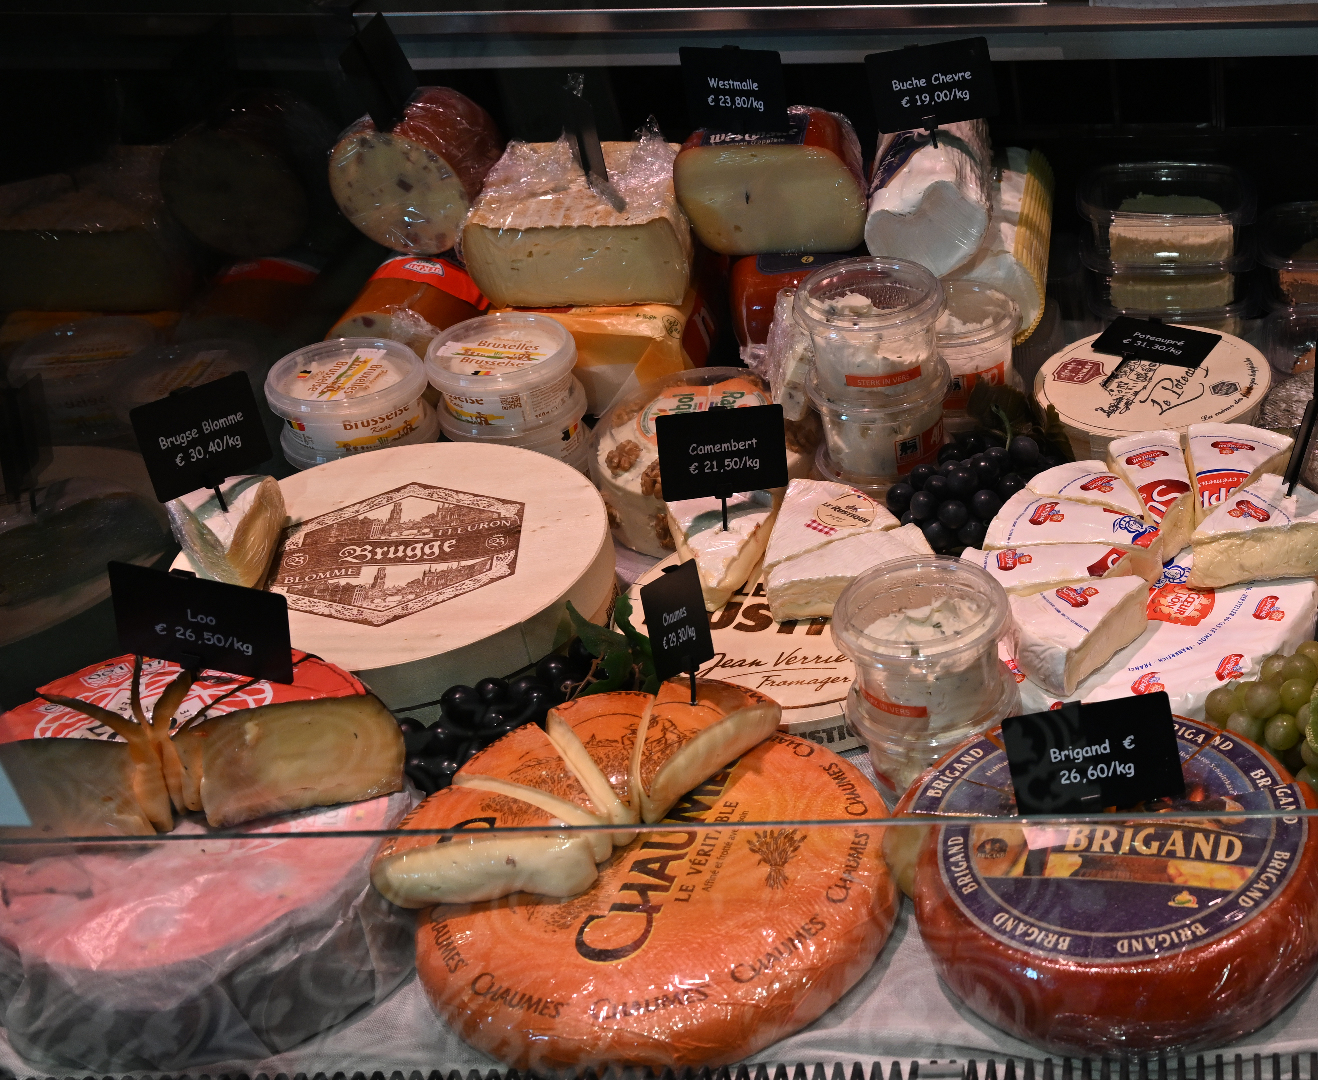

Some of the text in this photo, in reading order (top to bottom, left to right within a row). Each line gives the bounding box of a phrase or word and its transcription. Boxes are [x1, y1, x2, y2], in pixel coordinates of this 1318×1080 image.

[707, 76, 759, 90] Westmalle
[892, 71, 972, 91] Buche Chevre
[707, 94, 764, 112] € 23,80/kg
[901, 88, 970, 108] € 19,00/kg
[477, 340, 540, 352] Bruxelles
[1133, 331, 1185, 347] Poteaupré
[460, 355, 525, 368] Brusselse
[857, 378, 880, 386] STERK
[882, 377, 890, 385] IN
[158, 411, 244, 450] Brugse Blomme
[370, 423, 392, 434] Kaas
[175, 435, 242, 467] € 30,40/kg
[688, 437, 758, 456] Camembert
[689, 456, 760, 475] € 21,50/kg
[831, 504, 871, 524] RUSTIQUE
[438, 519, 512, 537] FLEURON
[338, 539, 458, 563] Brugge
[284, 567, 357, 585] BLOMME
[187, 608, 217, 627] Loo
[662, 606, 688, 627] Chaumes
[154, 623, 254, 656] € 26,50/kg
[662, 625, 697, 650] € 29,30/kg
[695, 652, 769, 678] Jean
[756, 674, 851, 691] Fromager
[1049, 735, 1135, 763] Brigand €
[926, 748, 984, 798] BRIGAND
[1060, 760, 1135, 786] 26,60/kg
[823, 762, 870, 817] CHAUMES
[674, 800, 740, 904] LE VÉRITBLE
[1064, 826, 1243, 863] BRIGAND
[825, 830, 870, 905] CHAUMES
[946, 836, 978, 896] BRIGAND
[1239, 850, 1292, 908] BRIGAND
[993, 911, 1072, 951] BRIGAND
[1116, 921, 1209, 954] BRIGAND
[731, 914, 828, 985] CHAUMES
[470, 972, 564, 1019] CHAUMES
[589, 984, 709, 1022] CHAUMES
